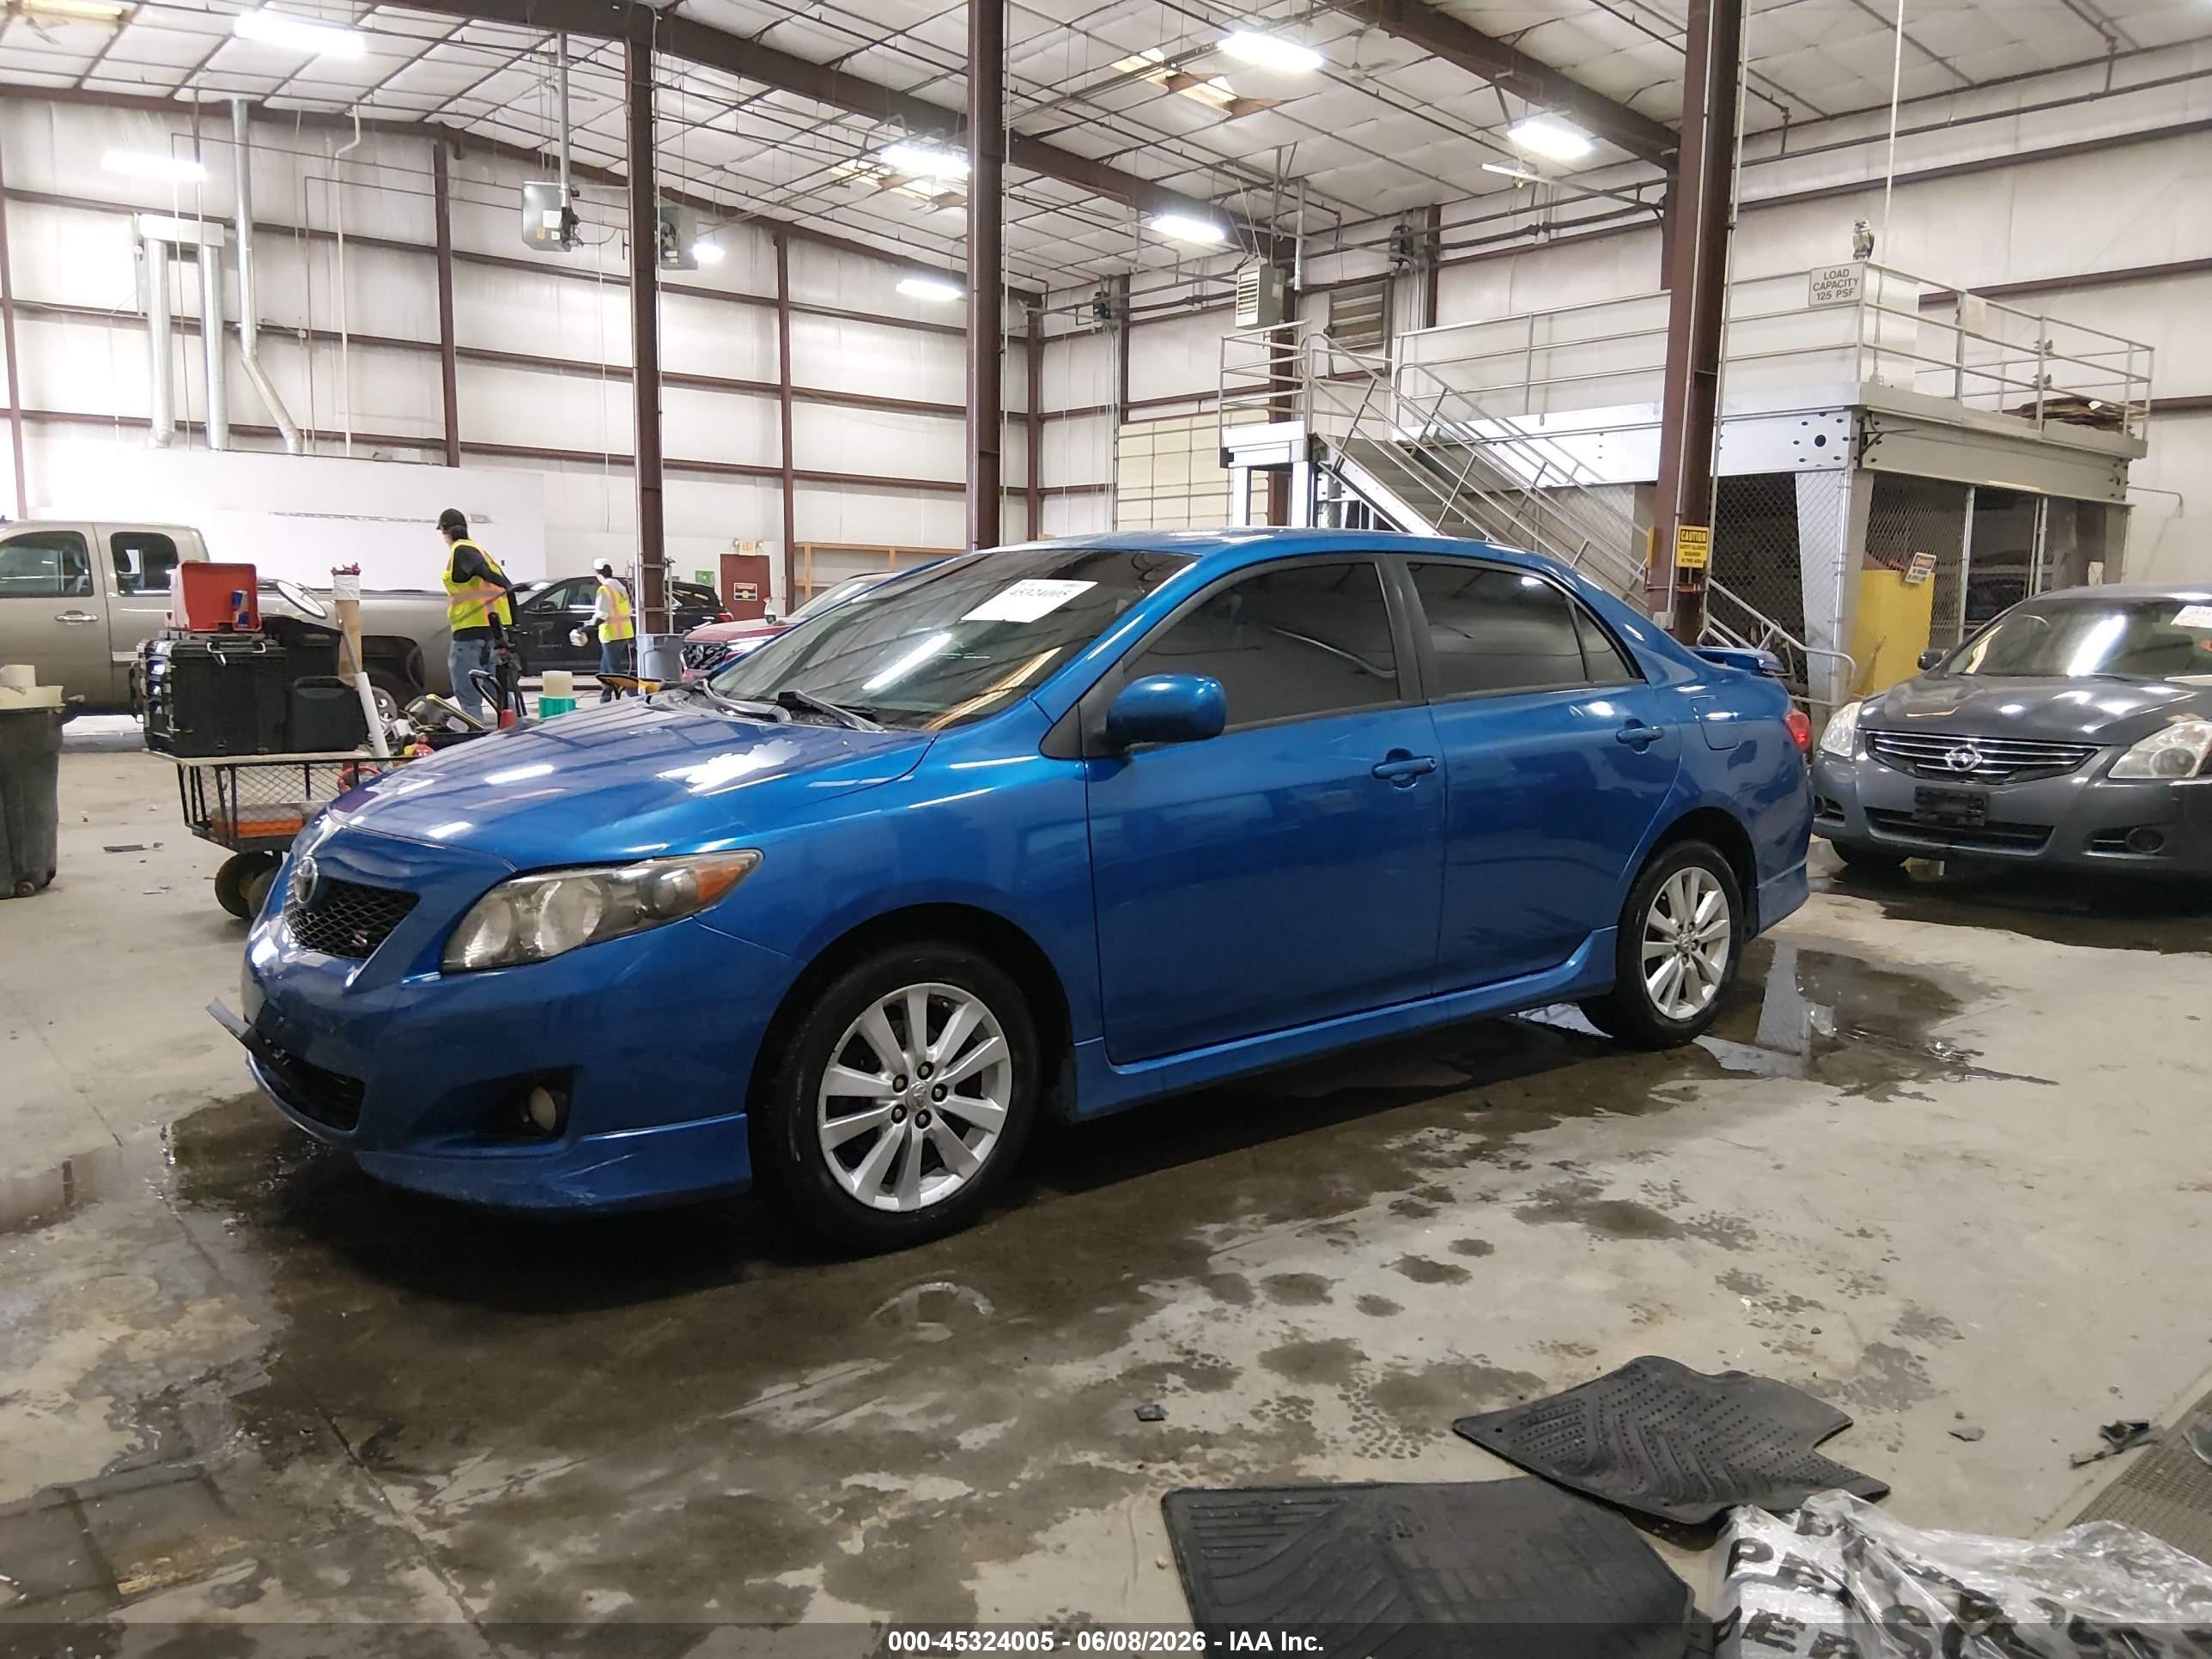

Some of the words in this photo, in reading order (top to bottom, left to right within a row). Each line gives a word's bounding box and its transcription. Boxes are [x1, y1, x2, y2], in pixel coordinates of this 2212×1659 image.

[1824, 269, 1850, 280] LOAD
[1813, 276, 1860, 292] CAPACITY
[1816, 291, 1832, 301] 125
[1836, 288, 1856, 298] PSF
[1681, 530, 1706, 542] CAUTION
